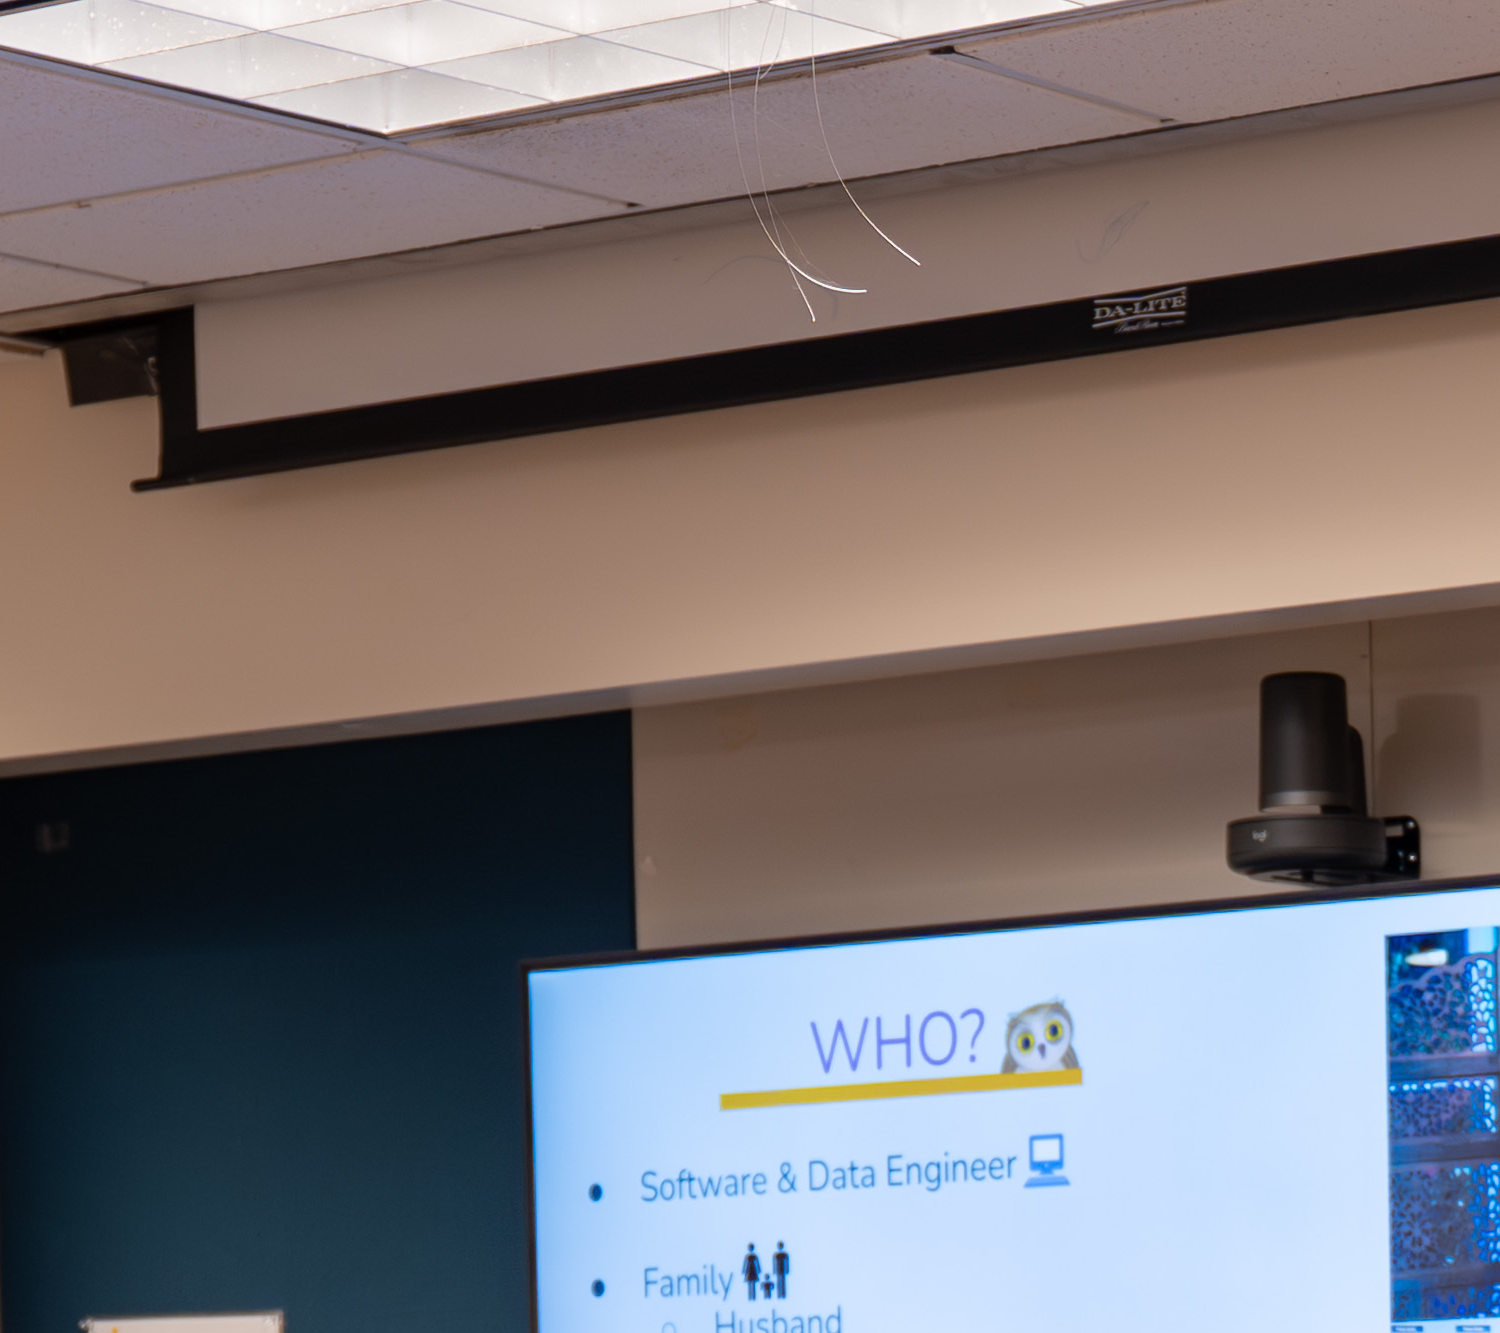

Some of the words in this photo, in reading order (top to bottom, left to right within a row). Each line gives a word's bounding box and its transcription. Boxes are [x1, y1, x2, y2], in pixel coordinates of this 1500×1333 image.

[1093, 295, 1187, 320] DA-LITE
[810, 1008, 985, 1074] WHO?
[640, 1168, 767, 1202] Software
[777, 1161, 797, 1193] &
[808, 1159, 875, 1192] Data
[887, 1150, 1017, 1192] Engineer
[643, 1265, 734, 1303] Family
